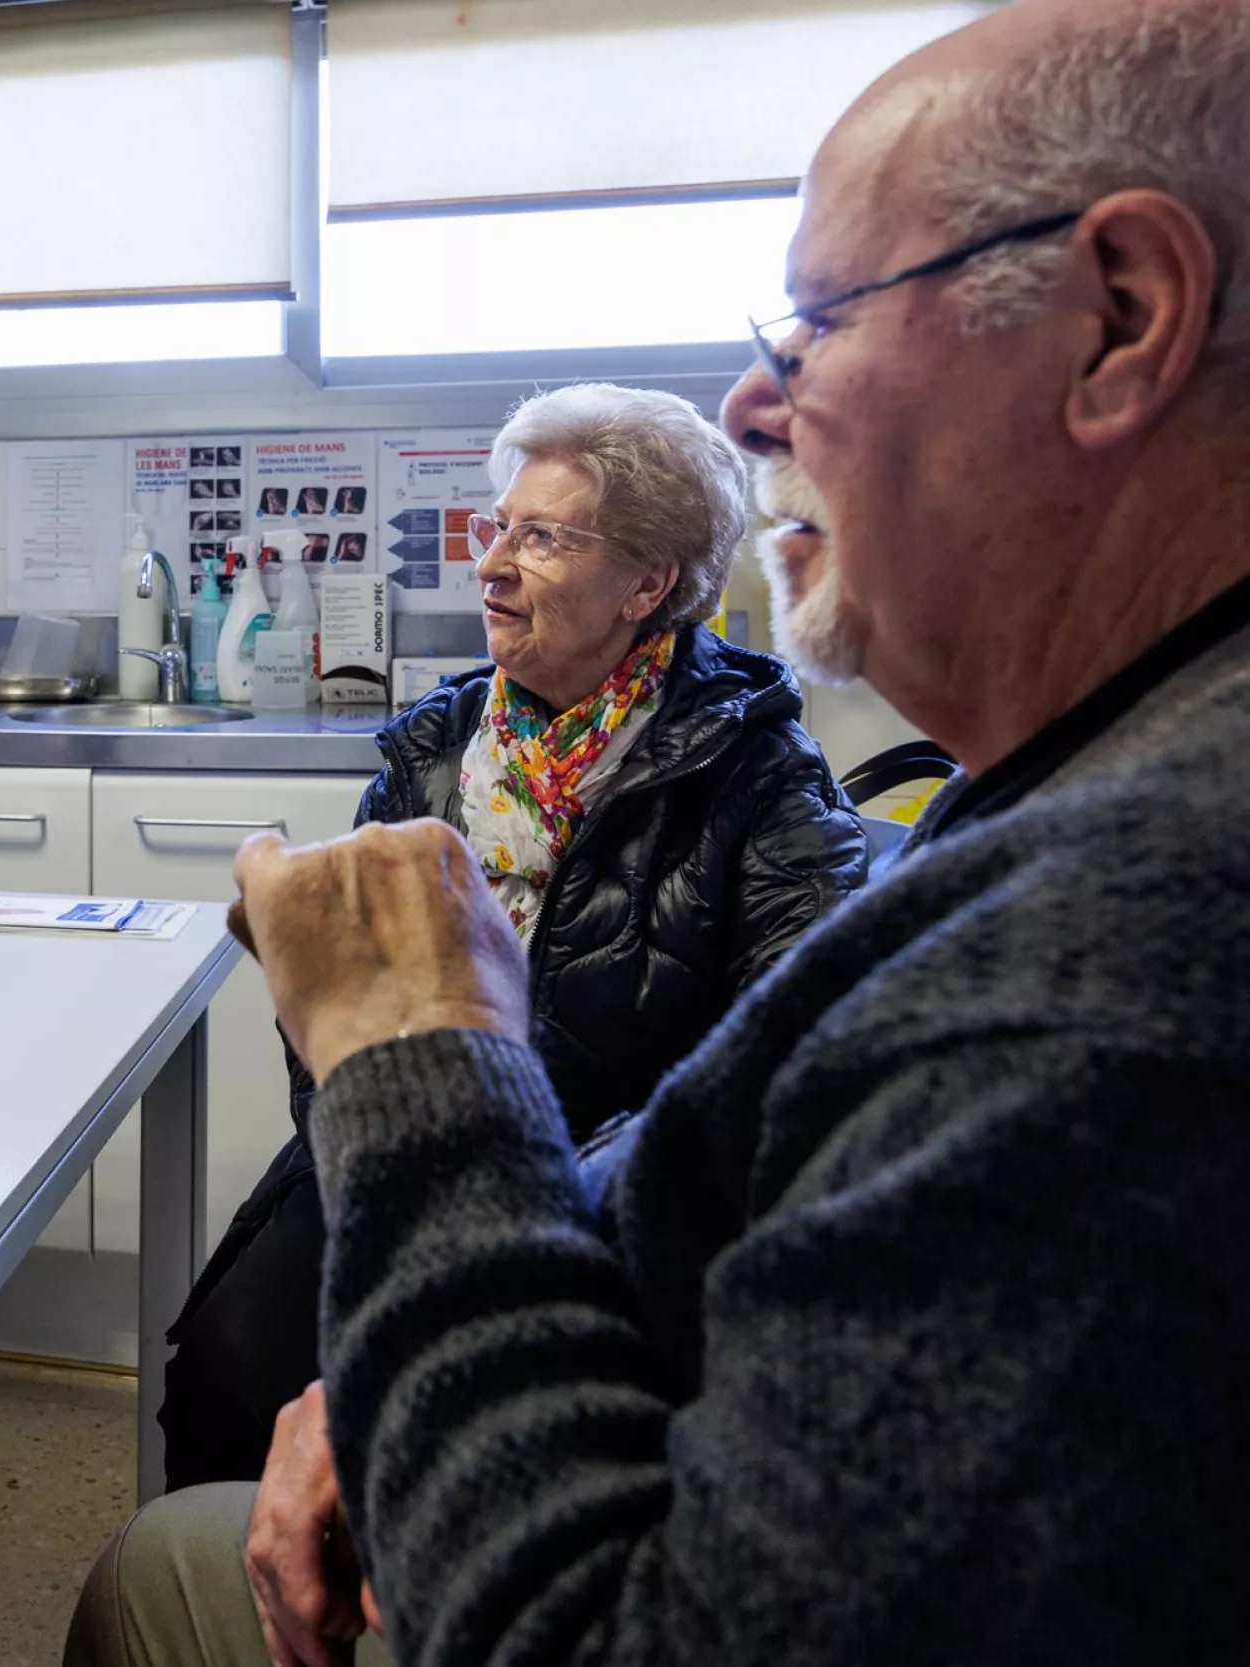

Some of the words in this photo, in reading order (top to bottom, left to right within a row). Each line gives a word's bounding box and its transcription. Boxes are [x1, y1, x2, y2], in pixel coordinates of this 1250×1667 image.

[135, 447, 171, 458] HIGIENE
[175, 446, 186, 457] DE
[256, 444, 296, 454] HIGIENE
[298, 443, 311, 453] DE
[314, 442, 346, 452] MANS
[135, 460, 152, 470] LES
[155, 459, 181, 470] MANS
[374, 582, 384, 606] SPEC
[374, 611, 384, 653] DORMO
